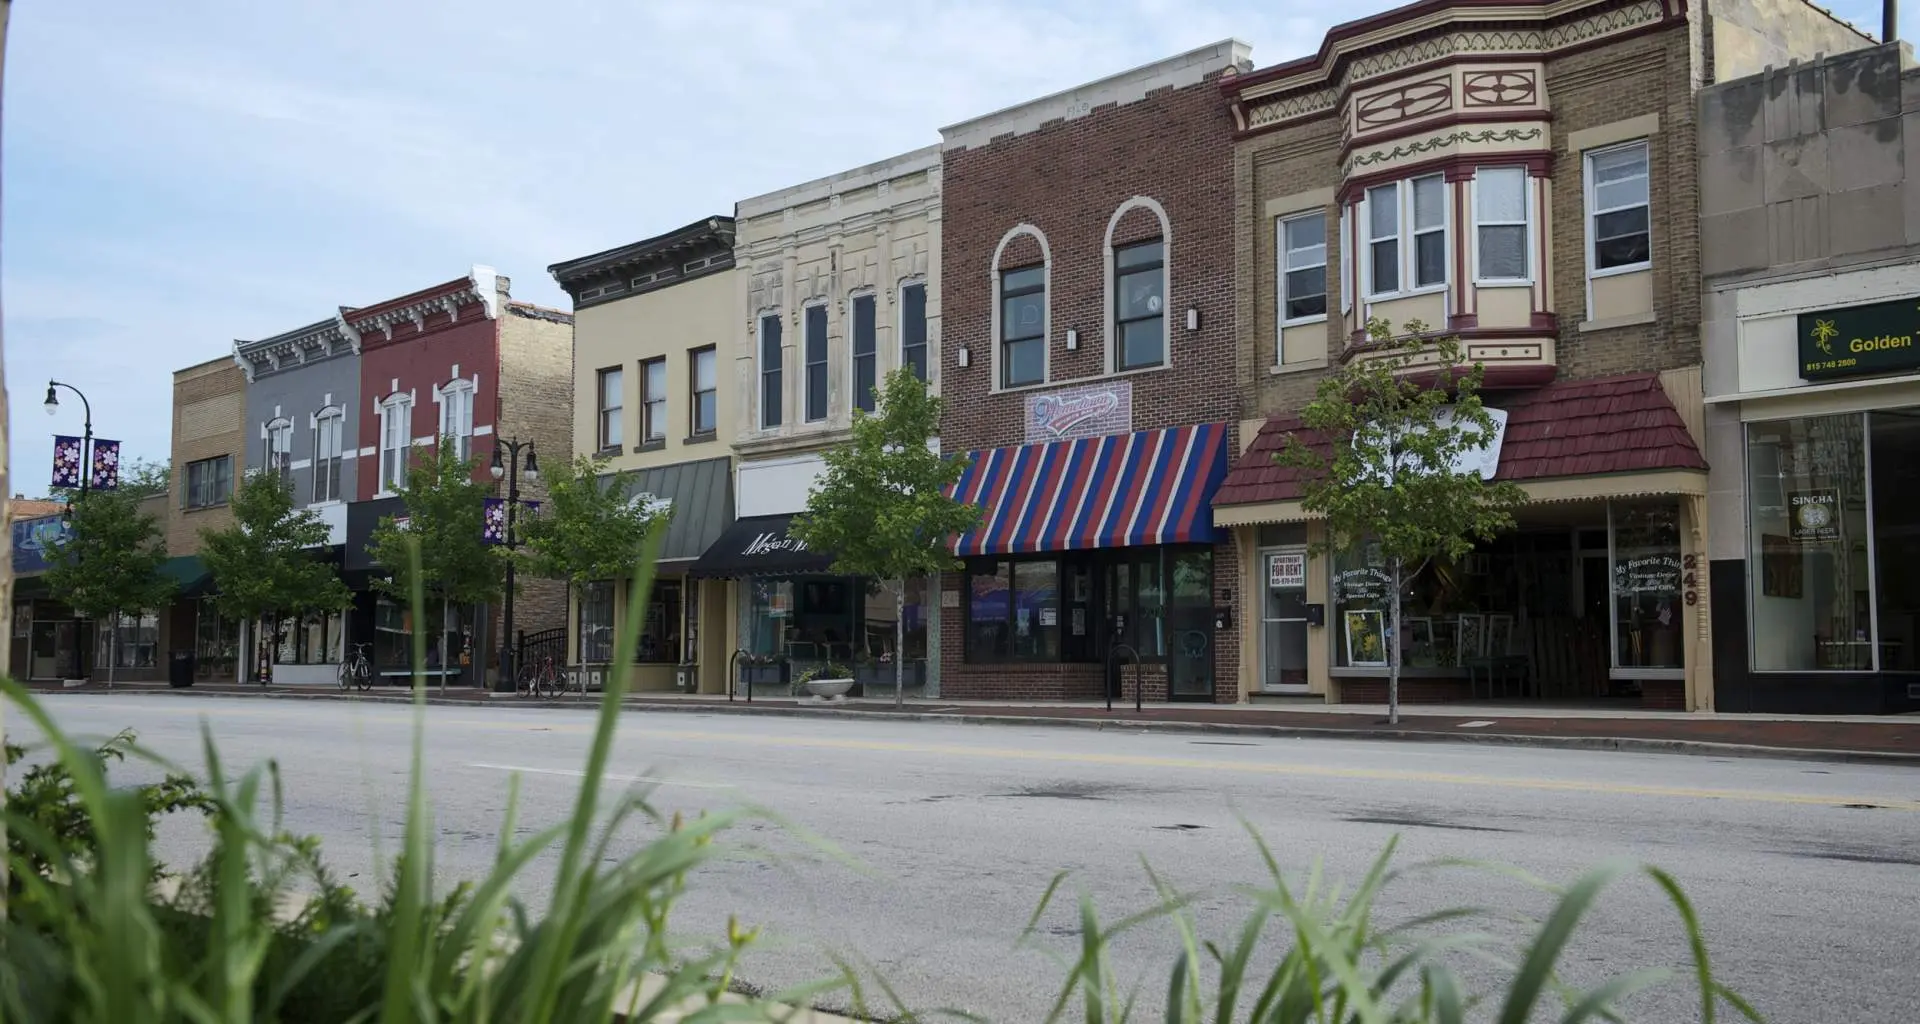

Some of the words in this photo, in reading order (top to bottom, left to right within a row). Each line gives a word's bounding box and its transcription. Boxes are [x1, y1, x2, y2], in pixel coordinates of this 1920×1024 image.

[1849, 334, 1912, 353] Golden
[1792, 495, 1833, 505] SINGHA
[1628, 556, 1661, 569] Favorite
[1272, 564, 1284, 577] FOR
[1285, 563, 1302, 576] RENT
[1683, 554, 1698, 606] 249
